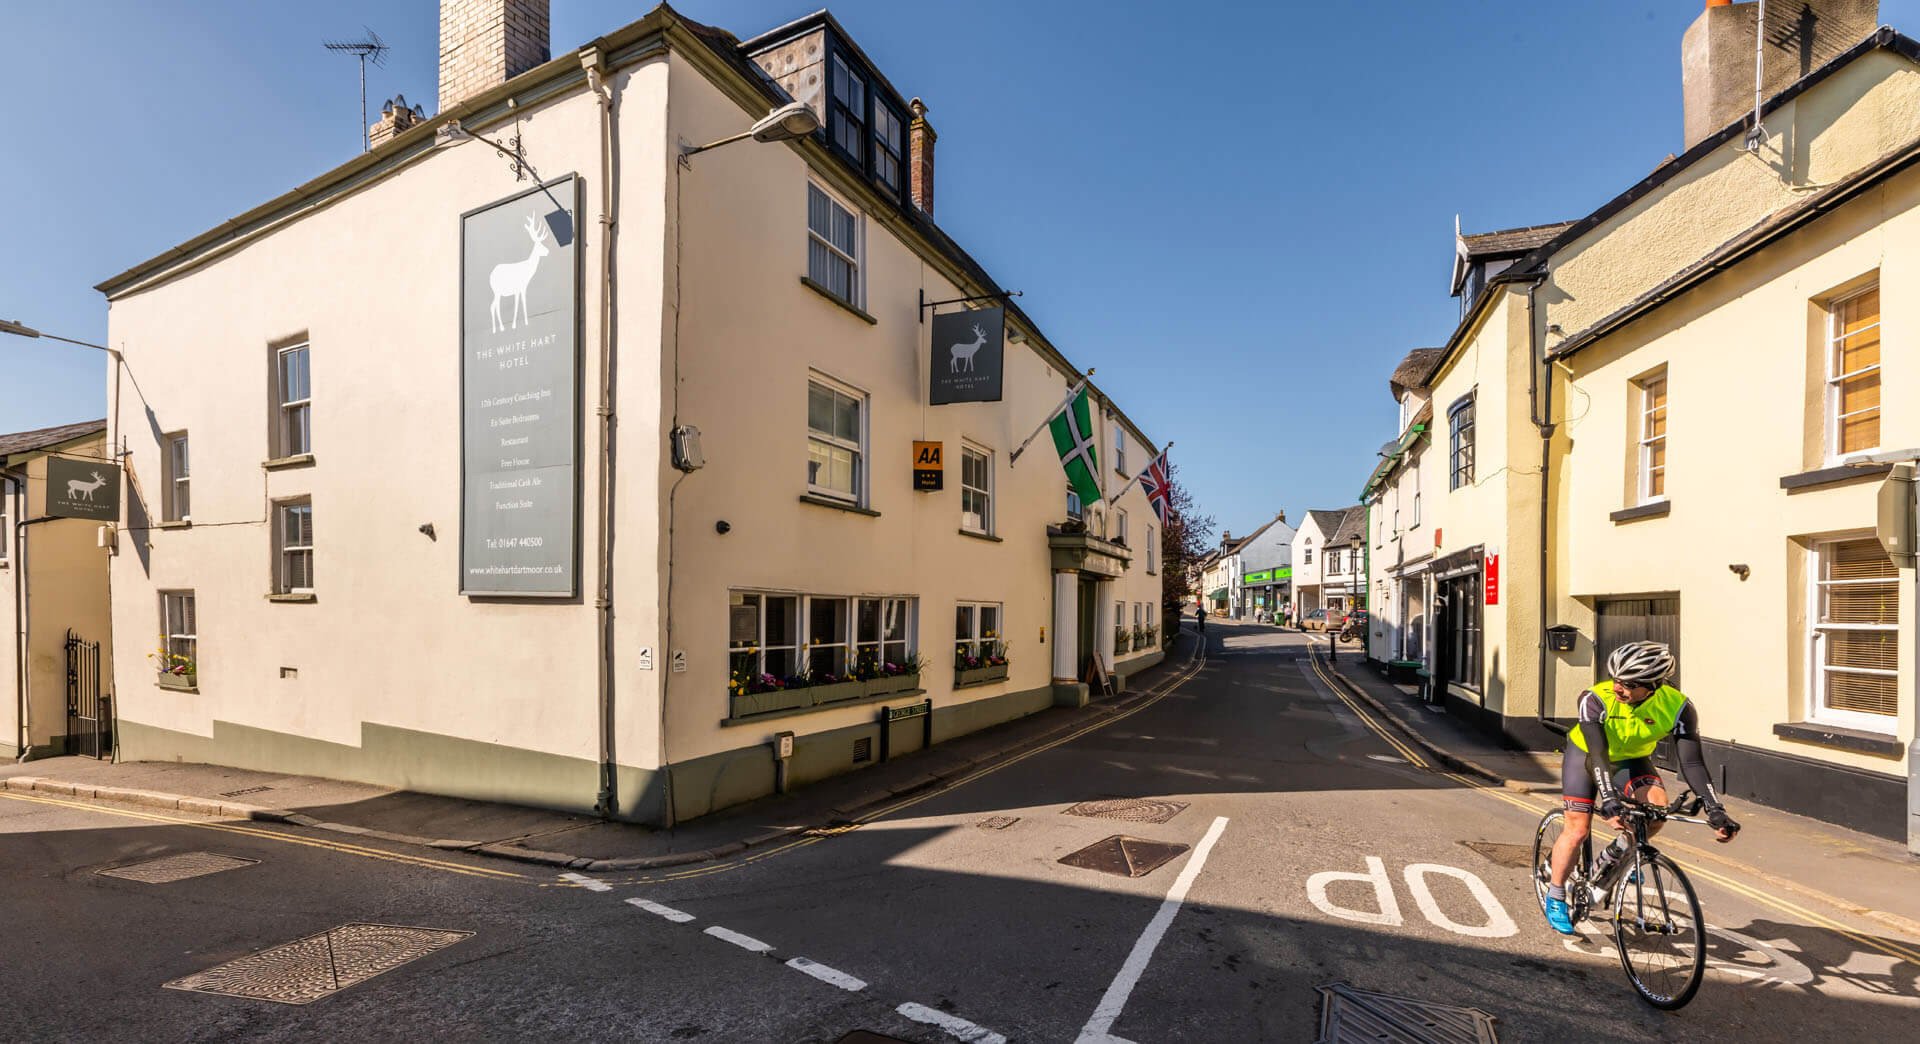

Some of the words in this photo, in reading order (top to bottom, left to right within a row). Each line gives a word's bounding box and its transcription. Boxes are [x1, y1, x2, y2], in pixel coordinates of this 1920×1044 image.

[477, 349, 492, 360] THE
[497, 340, 527, 355] WHITE
[530, 334, 556, 348] HART
[500, 355, 528, 368] HOTEL
[492, 396, 513, 405] Century
[514, 391, 540, 400] Coaching
[540, 388, 551, 397] Inn
[512, 414, 539, 424] Bedrooms
[501, 436, 529, 447] Restaurant
[512, 456, 530, 466] House
[917, 447, 940, 464] AA
[489, 479, 517, 489] Traditional
[518, 478, 530, 487] Cask
[532, 476, 541, 486] Ale
[496, 501, 518, 509] Function
[520, 499, 533, 508] Suite
[498, 537, 517, 548] 01647
[519, 537, 543, 548] 440500
